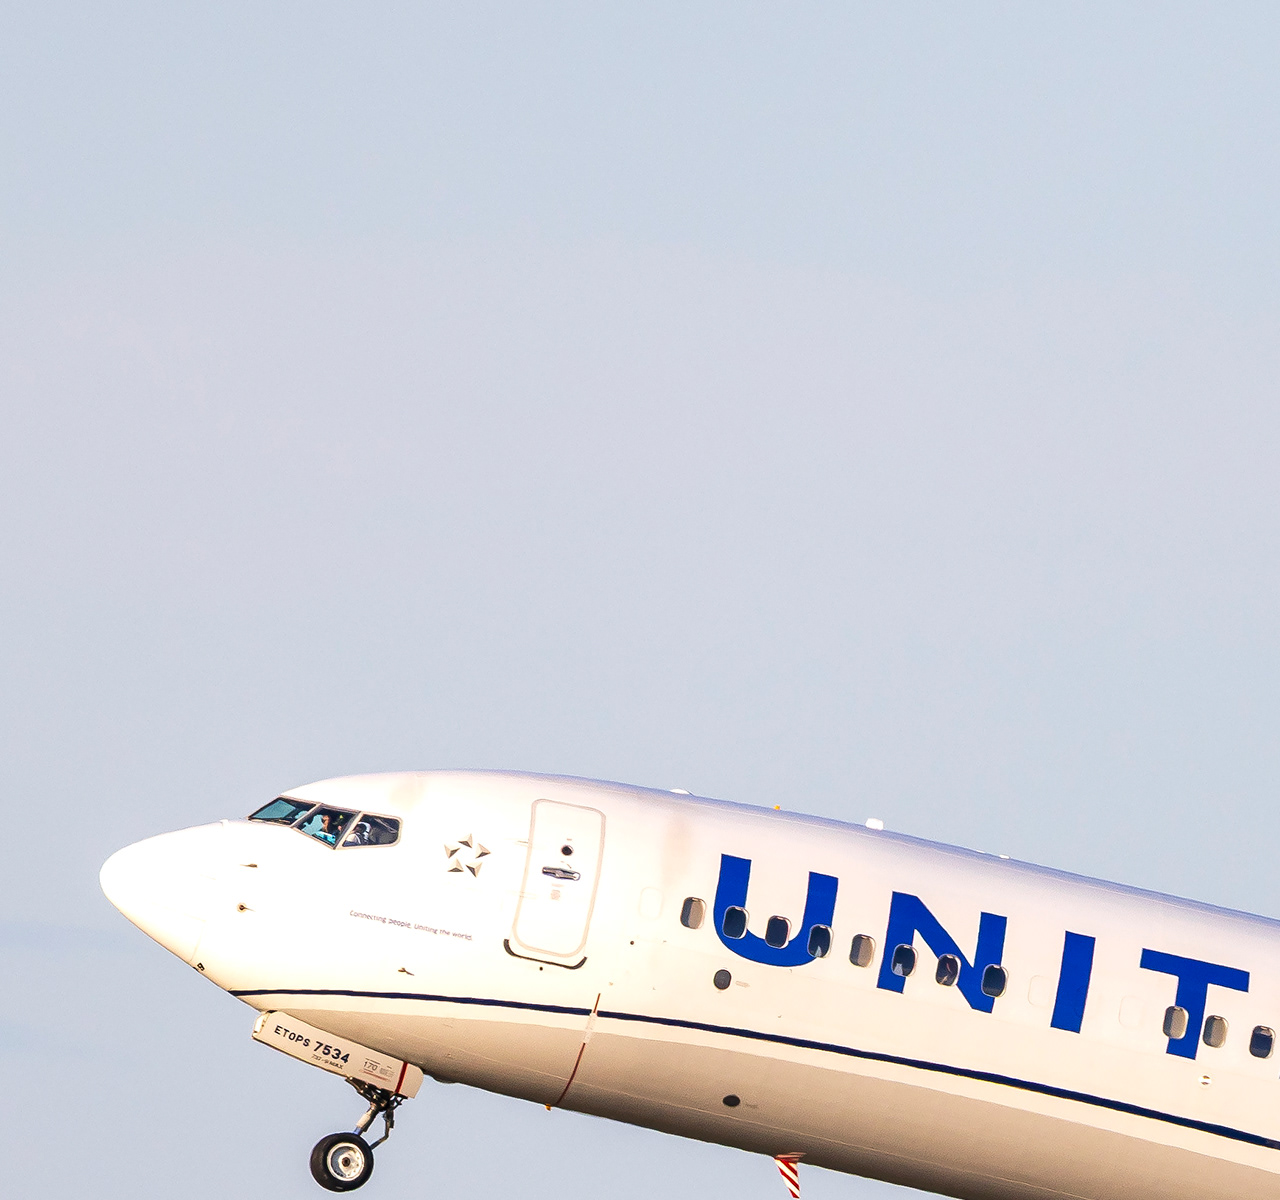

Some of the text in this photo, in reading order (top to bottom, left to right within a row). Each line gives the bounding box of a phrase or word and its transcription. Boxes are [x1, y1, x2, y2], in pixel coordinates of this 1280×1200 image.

[349, 910, 387, 924] Connecting
[414, 923, 438, 934] Uniting
[274, 1025, 351, 1064] ETOPS 7534
[363, 1061, 378, 1071] 170
